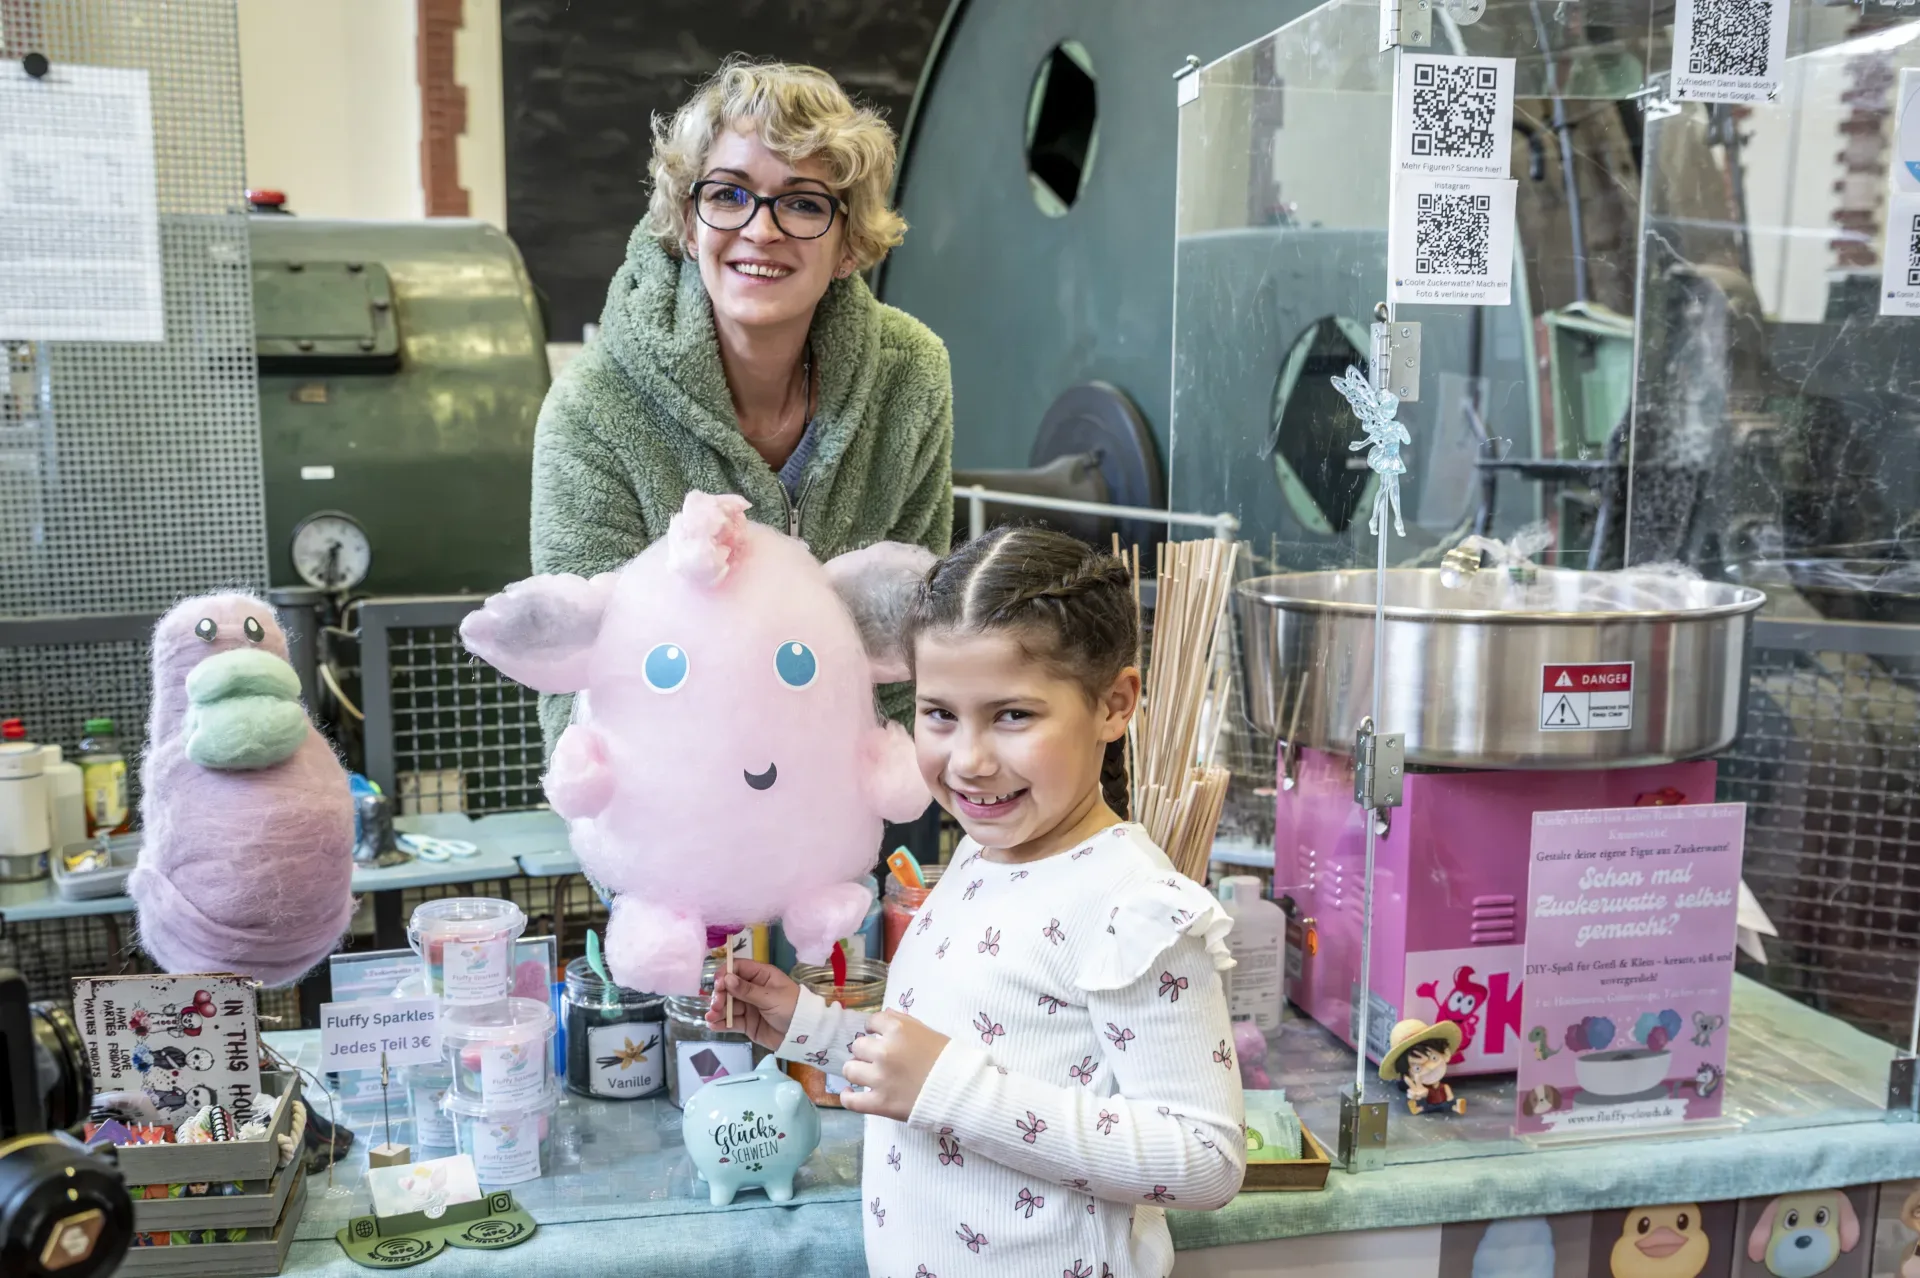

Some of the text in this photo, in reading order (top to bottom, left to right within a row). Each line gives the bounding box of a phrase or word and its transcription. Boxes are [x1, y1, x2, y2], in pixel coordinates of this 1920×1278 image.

[1677, 77, 1716, 86] Zufrieden?
[1717, 79, 1736, 87] Dann
[1737, 80, 1751, 88] lass
[1753, 81, 1770, 89] doch
[1692, 90, 1716, 98] Sterne
[1717, 90, 1728, 98] bei
[1402, 162, 1421, 170] Mehr
[1423, 163, 1455, 172] Figuren?
[1485, 166, 1502, 174] hier!
[1434, 182, 1471, 191] Instagram
[1427, 279, 1475, 287] Zuckerwatte?
[1416, 290, 1433, 298] Foto
[1581, 673, 1628, 685] DANGER
[1536, 842, 1731, 862] Gestalte deine eigene Figur aus Zuckerwatte!
[1579, 862, 1693, 890] Schon mal
[1535, 886, 1733, 918] Zuckerwatte selbst
[1575, 913, 1681, 948] gemacht?
[1526, 963, 1574, 976] DIY-Spaß
[1576, 961, 1591, 971] für
[1593, 960, 1616, 970] Groß
[1619, 958, 1628, 968] &
[1631, 957, 1655, 968] Klein
[1716, 952, 1733, 962] und
[103, 999, 117, 1037] PARTIES
[327, 1010, 435, 1030] Fluffy Sparkles
[116, 1007, 132, 1071] HAVE LOVE
[330, 1035, 432, 1056] Jedes Teil 3€
[108, 1042, 122, 1079] FRIDAYS
[221, 1000, 254, 1126] IN THIS HOU
[607, 1075, 652, 1090] Vanille
[709, 1115, 779, 1155] Glücks
[731, 1139, 779, 1165] SCHWEIN
